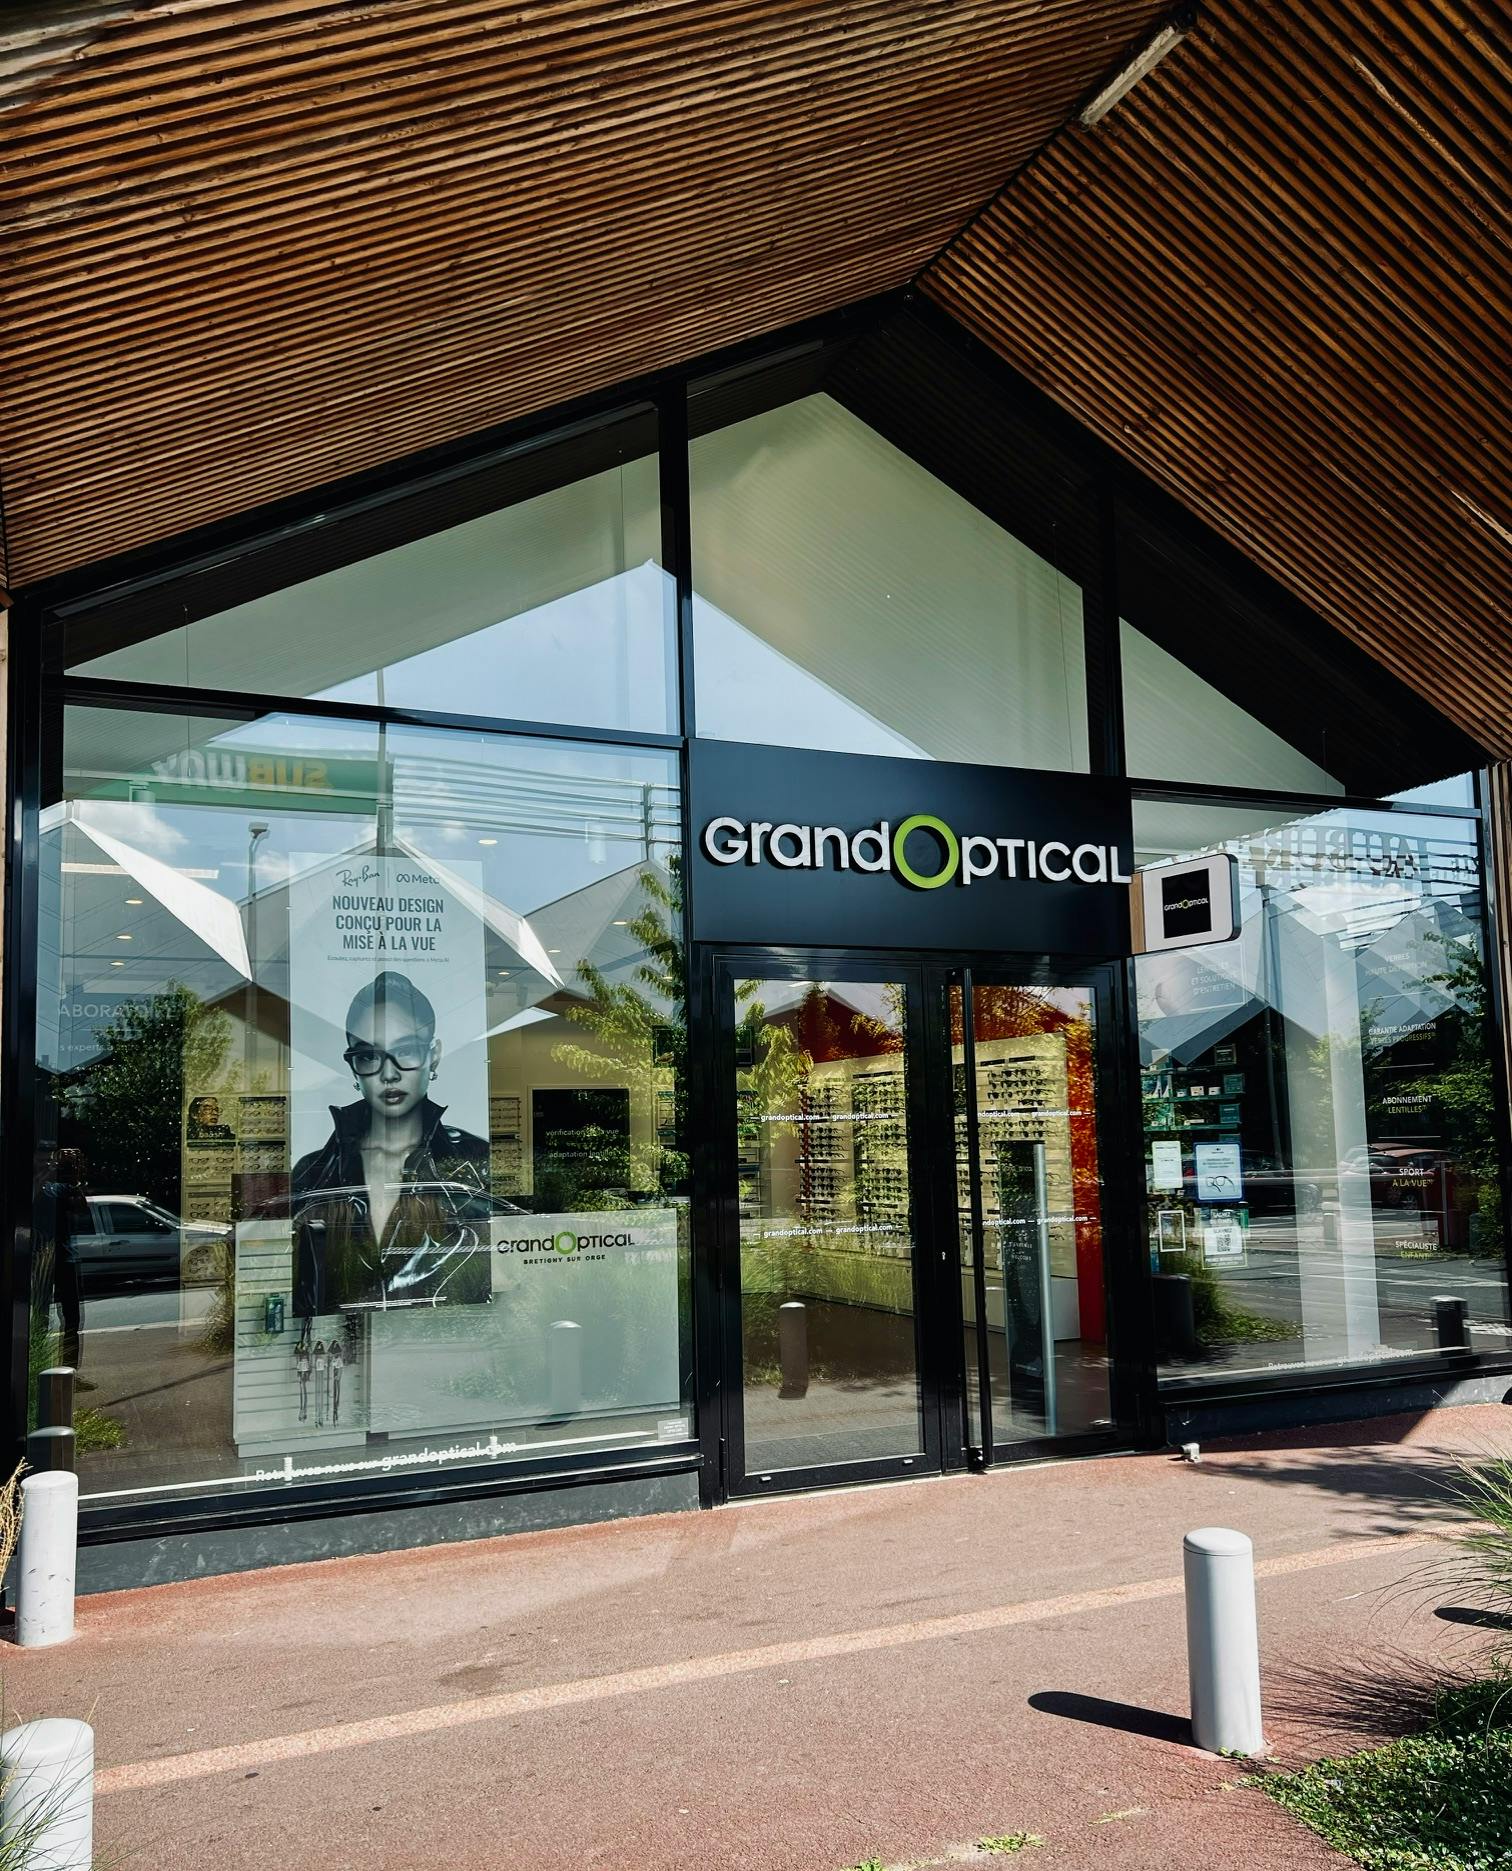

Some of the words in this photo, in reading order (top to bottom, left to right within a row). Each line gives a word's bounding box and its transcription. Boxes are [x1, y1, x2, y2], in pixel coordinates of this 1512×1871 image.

[336, 865, 380, 887] Ray-Ban
[333, 895, 394, 911] NOUVEAU
[399, 898, 444, 913] DESIGN
[336, 915, 381, 934] CONÇU
[386, 917, 421, 931] POUR
[426, 918, 442, 932] LA
[343, 935, 374, 950] MISE
[378, 932, 387, 950] À
[392, 936, 407, 950] LA
[411, 937, 436, 950] VUE
[1398, 1022, 1437, 1033] ADAPTATION
[1382, 1095, 1432, 1105] ABONNEMENT
[760, 1112, 820, 1122] grandoptical.com
[832, 1111, 889, 1121] grandoptical.com
[1399, 1168, 1424, 1176] SPORT
[763, 1227, 823, 1238] grandoptical.com
[835, 1224, 893, 1235] grandoptical.com
[1395, 1240, 1437, 1251] SPÉCIALISTE
[523, 1257, 563, 1265] BRETIGNY
